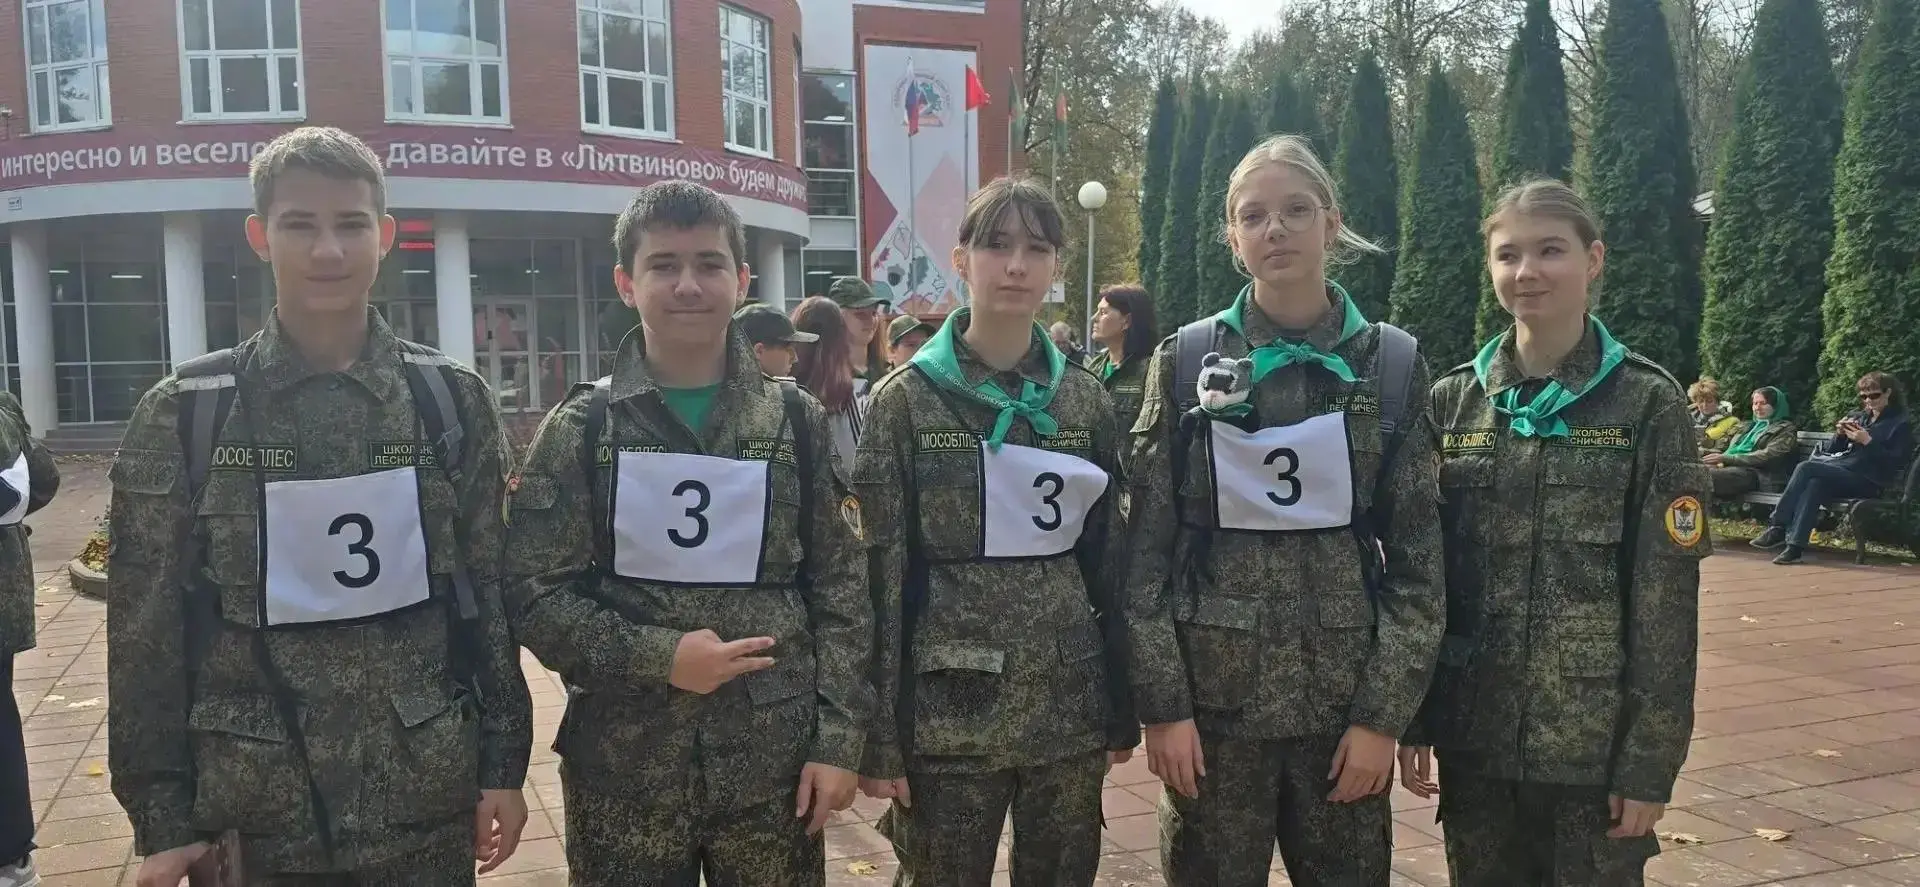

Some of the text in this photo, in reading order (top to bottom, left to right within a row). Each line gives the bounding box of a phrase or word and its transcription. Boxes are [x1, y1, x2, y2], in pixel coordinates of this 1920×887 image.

[2, 146, 122, 179] интересно
[129, 145, 147, 166] и
[386, 137, 526, 169] давайте
[536, 148, 553, 168] в
[561, 144, 725, 181] «Литвиново»
[728, 160, 775, 193] будем
[748, 440, 794, 454] ШКОЛНОЕ
[1263, 447, 1303, 507] 3
[667, 479, 711, 549] 3
[1031, 471, 1064, 532] 3
[328, 512, 381, 589] 3
